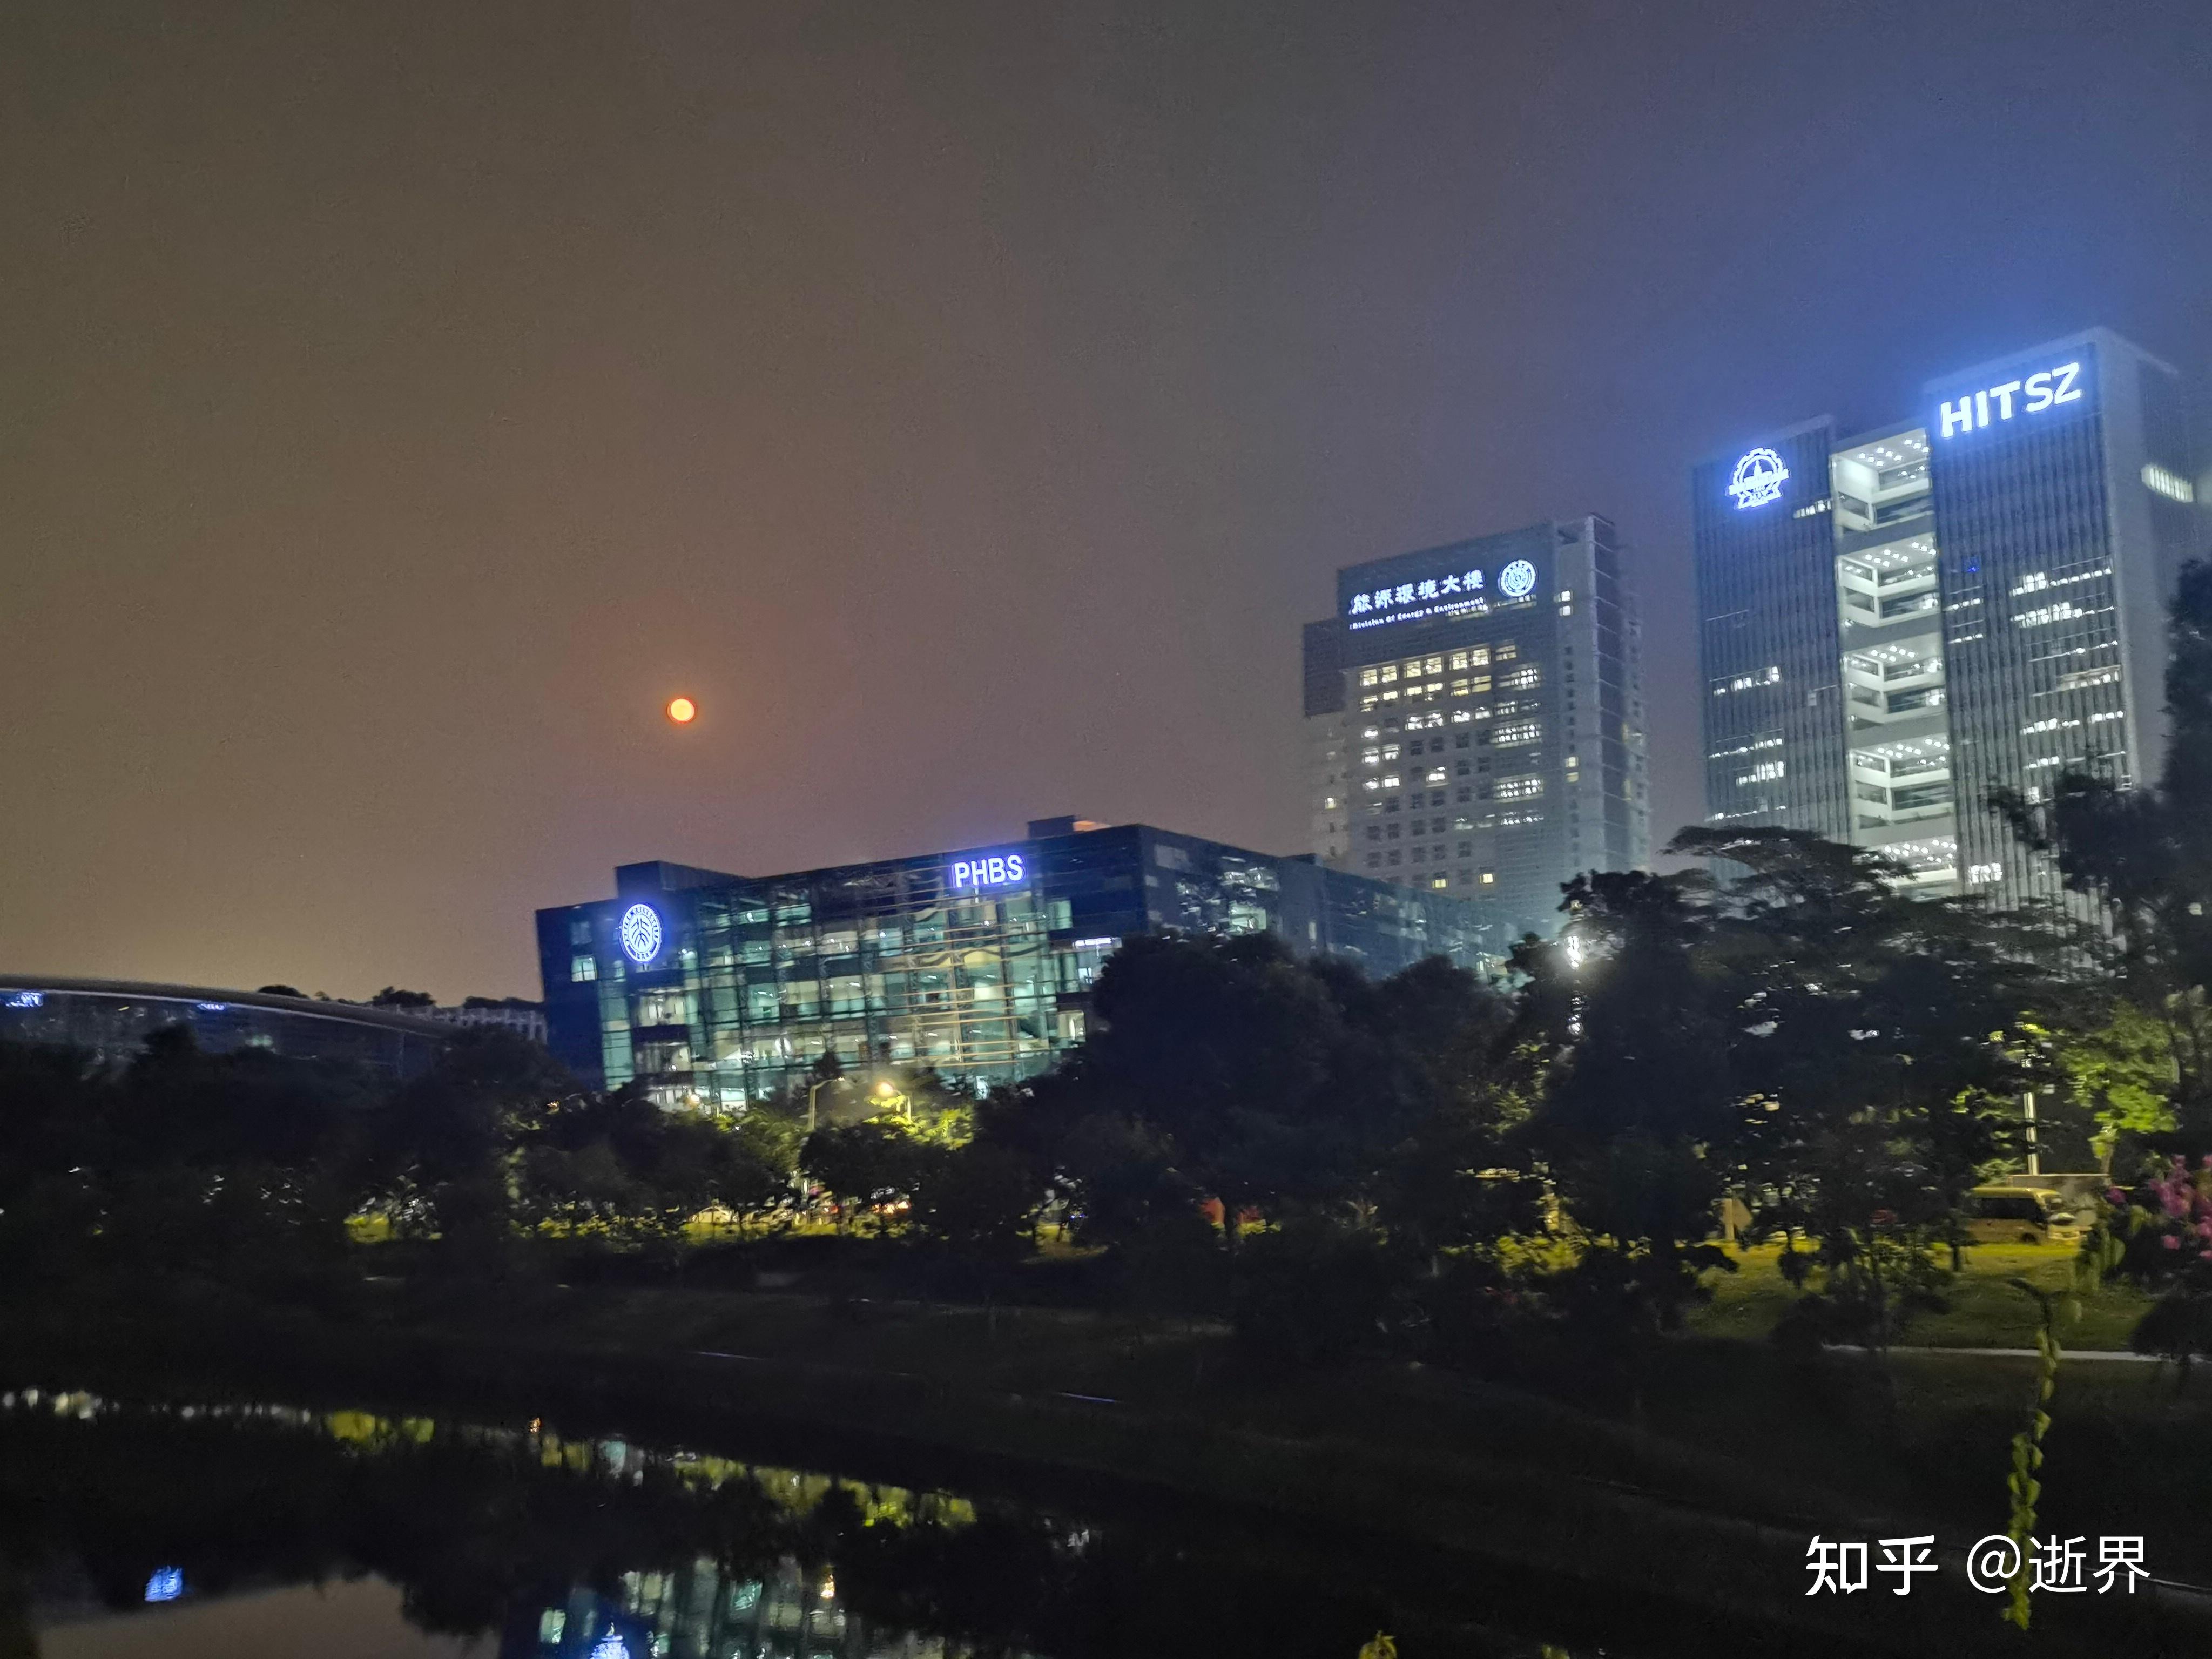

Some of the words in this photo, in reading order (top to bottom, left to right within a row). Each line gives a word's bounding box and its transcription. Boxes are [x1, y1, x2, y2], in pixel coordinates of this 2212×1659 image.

[1940, 362, 2082, 439] HITSZ
[1352, 618, 1384, 630] Division
[1397, 610, 1424, 621] Energy
[953, 854, 1024, 888] PHBS
